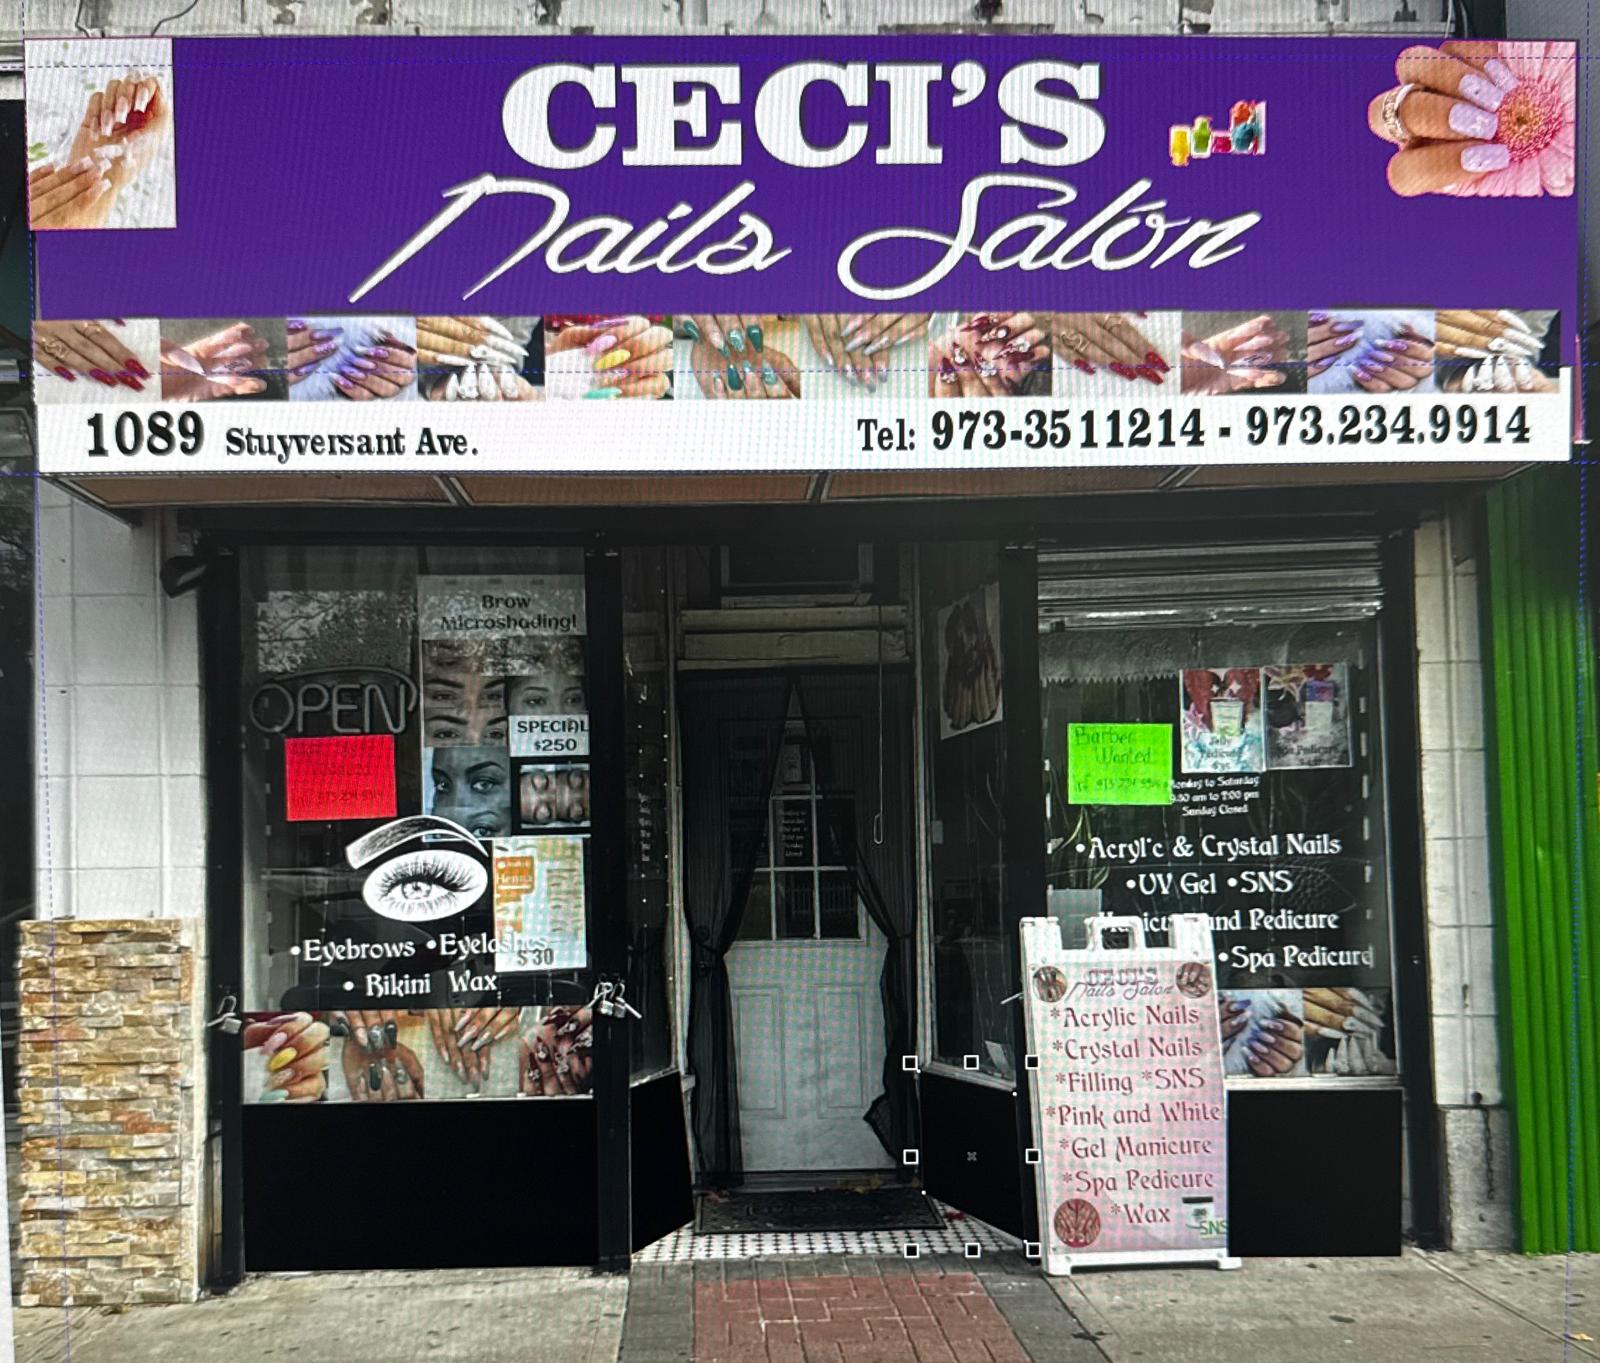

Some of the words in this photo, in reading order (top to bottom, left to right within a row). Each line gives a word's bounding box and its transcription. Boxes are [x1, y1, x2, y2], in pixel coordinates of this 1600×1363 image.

[501, 60, 1105, 169] CECI'S
[347, 173, 792, 302] Nails
[87, 410, 204, 457] 1089
[226, 426, 406, 464] Stuyversant
[416, 427, 478, 456] Ave.
[857, 418, 917, 452] Tel:
[1246, 404, 1531, 445] 973.234.9914
[481, 594, 531, 609] Brow
[440, 613, 576, 633] Microshading!
[249, 682, 406, 734] OPEN
[517, 719, 589, 734] SPECIAL
[534, 739, 577, 752] $250
[1204, 778, 1215, 788] to
[1216, 776, 1260, 788] Saturday
[1172, 835, 1194, 857] &
[1201, 833, 1279, 861] Crystal
[1286, 832, 1342, 855] Nails
[1138, 873, 1172, 895] UV
[1180, 872, 1217, 894] Gel
[1240, 870, 1294, 893] SNS
[1248, 908, 1340, 931] Pedicure
[303, 938, 416, 966] Eyebrows
[533, 949, 555, 965] 30
[1231, 945, 1276, 973] Spa
[365, 973, 430, 997] Bikini
[447, 970, 498, 992] Wax
[1063, 1007, 1138, 1031] Acrylic
[1146, 1004, 1200, 1025] Nails
[1064, 1039, 1140, 1064] Crystal
[1149, 1036, 1203, 1058] Nails
[1068, 1071, 1133, 1095] Filling
[1155, 1067, 1206, 1090] SNS
[1058, 1105, 1106, 1129] Pink
[1113, 1104, 1152, 1123] and
[1160, 1101, 1221, 1122] White
[1071, 1137, 1106, 1159] Gel
[1115, 1135, 1212, 1162] Manicure
[1075, 1171, 1118, 1197] Spa
[1126, 1168, 1214, 1190] Pedicure
[1123, 1203, 1172, 1224] Wax
